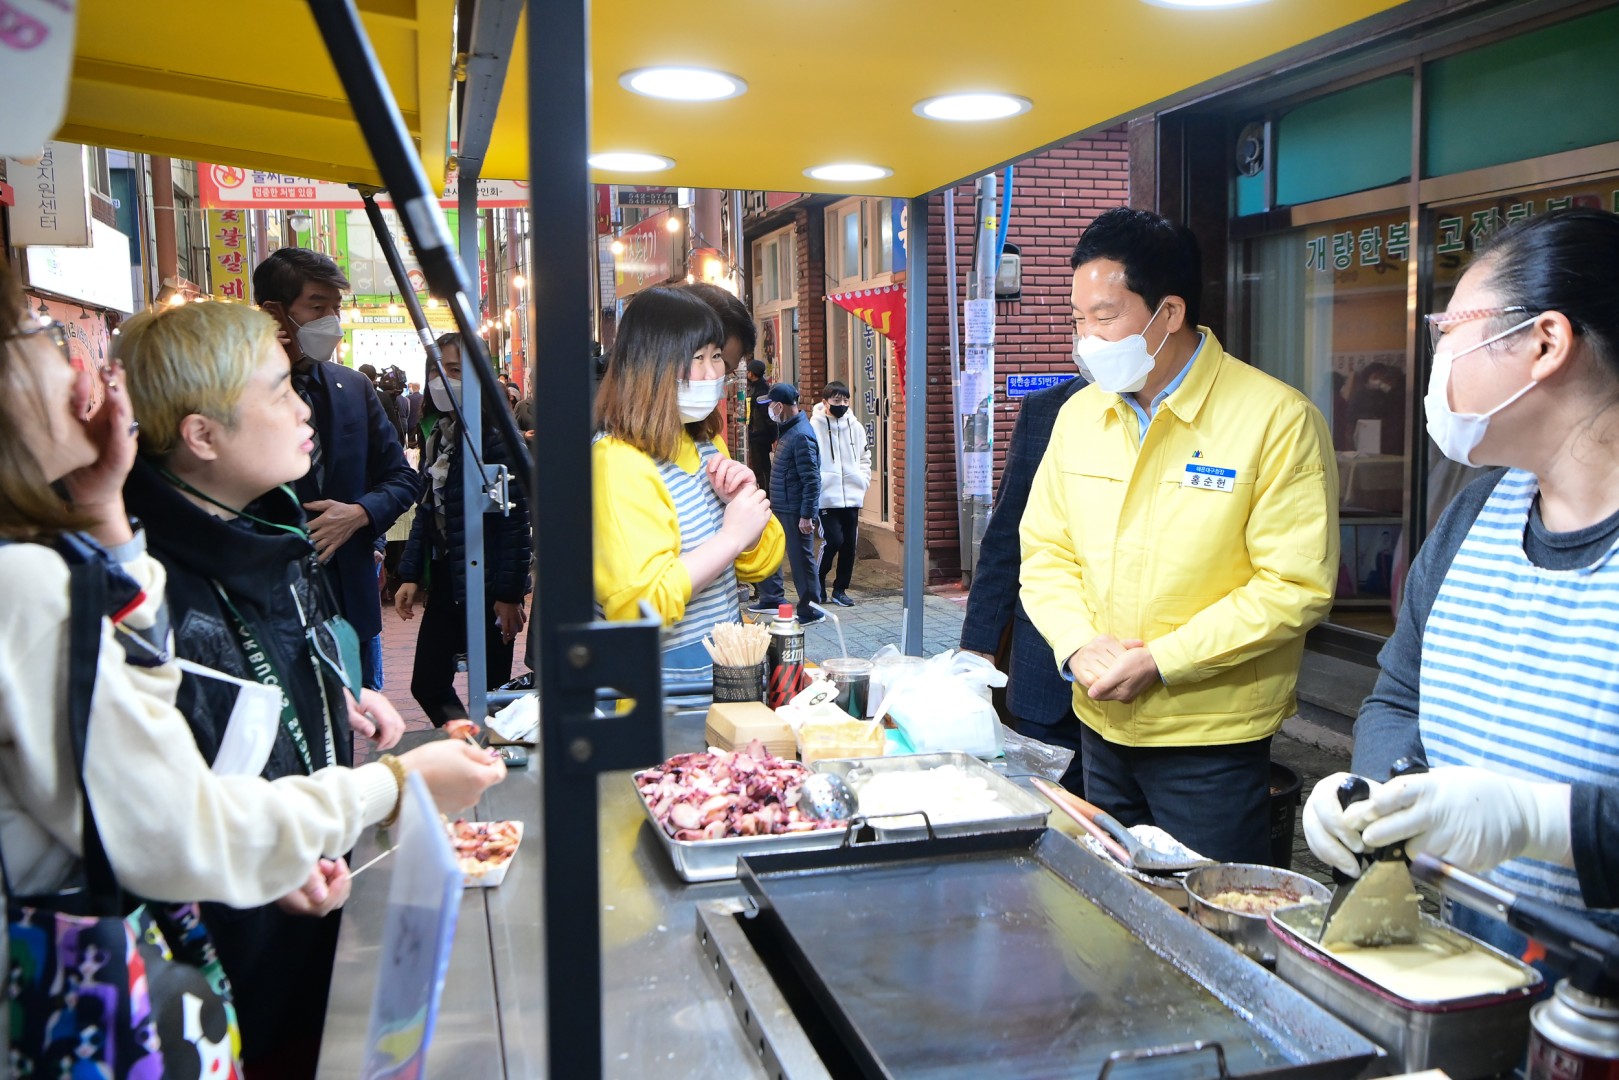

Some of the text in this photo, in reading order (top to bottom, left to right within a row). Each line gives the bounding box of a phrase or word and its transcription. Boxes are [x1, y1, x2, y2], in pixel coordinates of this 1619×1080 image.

[254, 187, 314, 198] 엄중한 처벌 있음
[1305, 221, 1411, 272] 개량한복
[863, 323, 876, 449] 동원반점
